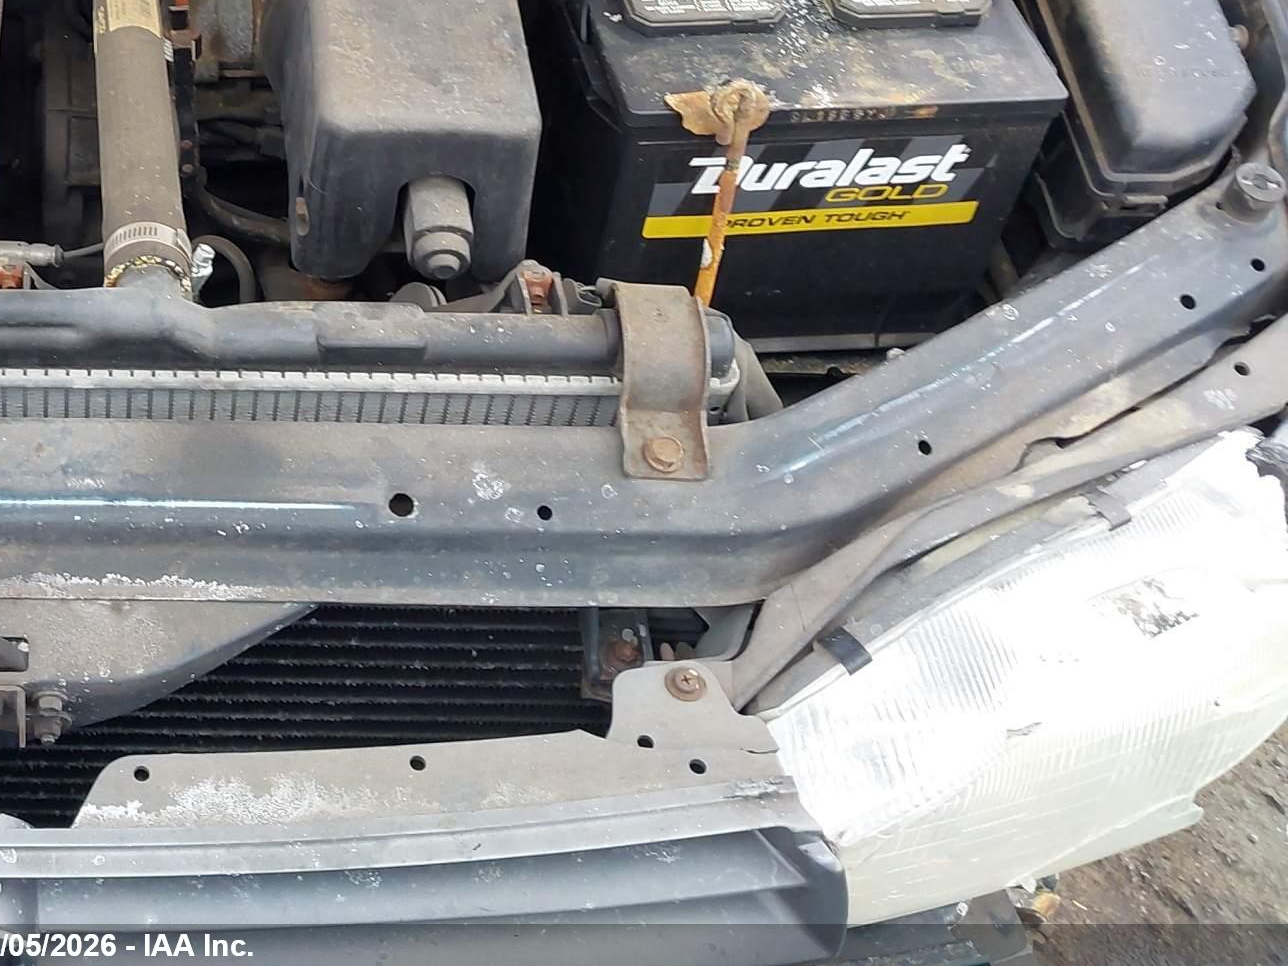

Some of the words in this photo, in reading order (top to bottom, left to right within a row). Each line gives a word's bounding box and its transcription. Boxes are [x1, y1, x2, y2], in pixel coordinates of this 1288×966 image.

[688, 144, 971, 195] Duralast
[824, 183, 950, 203] GOLD
[825, 210, 905, 223] TOUGH
